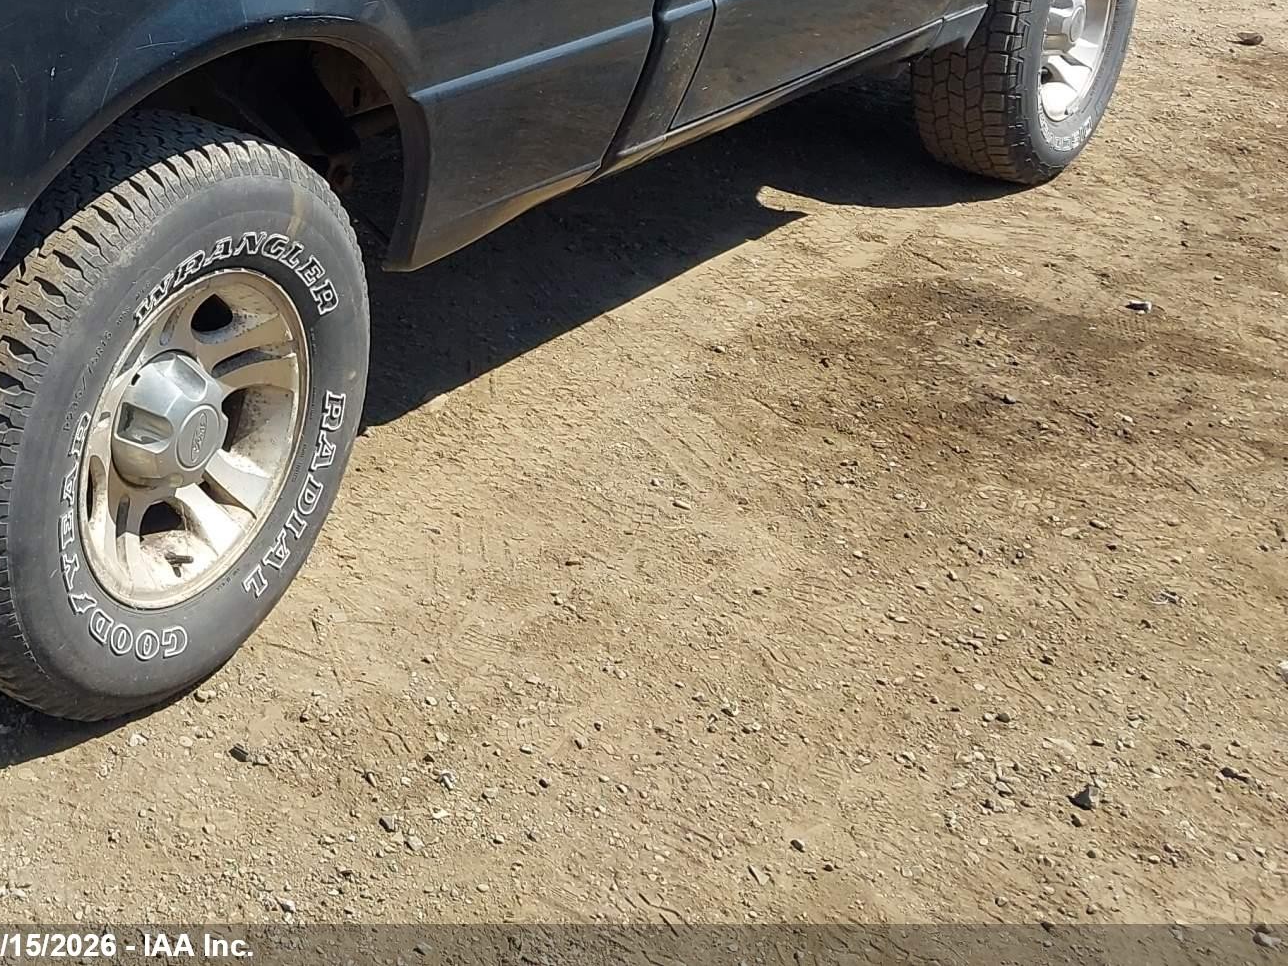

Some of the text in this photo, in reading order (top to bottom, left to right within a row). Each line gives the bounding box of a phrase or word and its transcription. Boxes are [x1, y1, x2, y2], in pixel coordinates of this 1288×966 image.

[134, 231, 339, 326] WRANGLER
[60, 411, 188, 660] GOODYEAR
[243, 389, 346, 598] RADIAL
